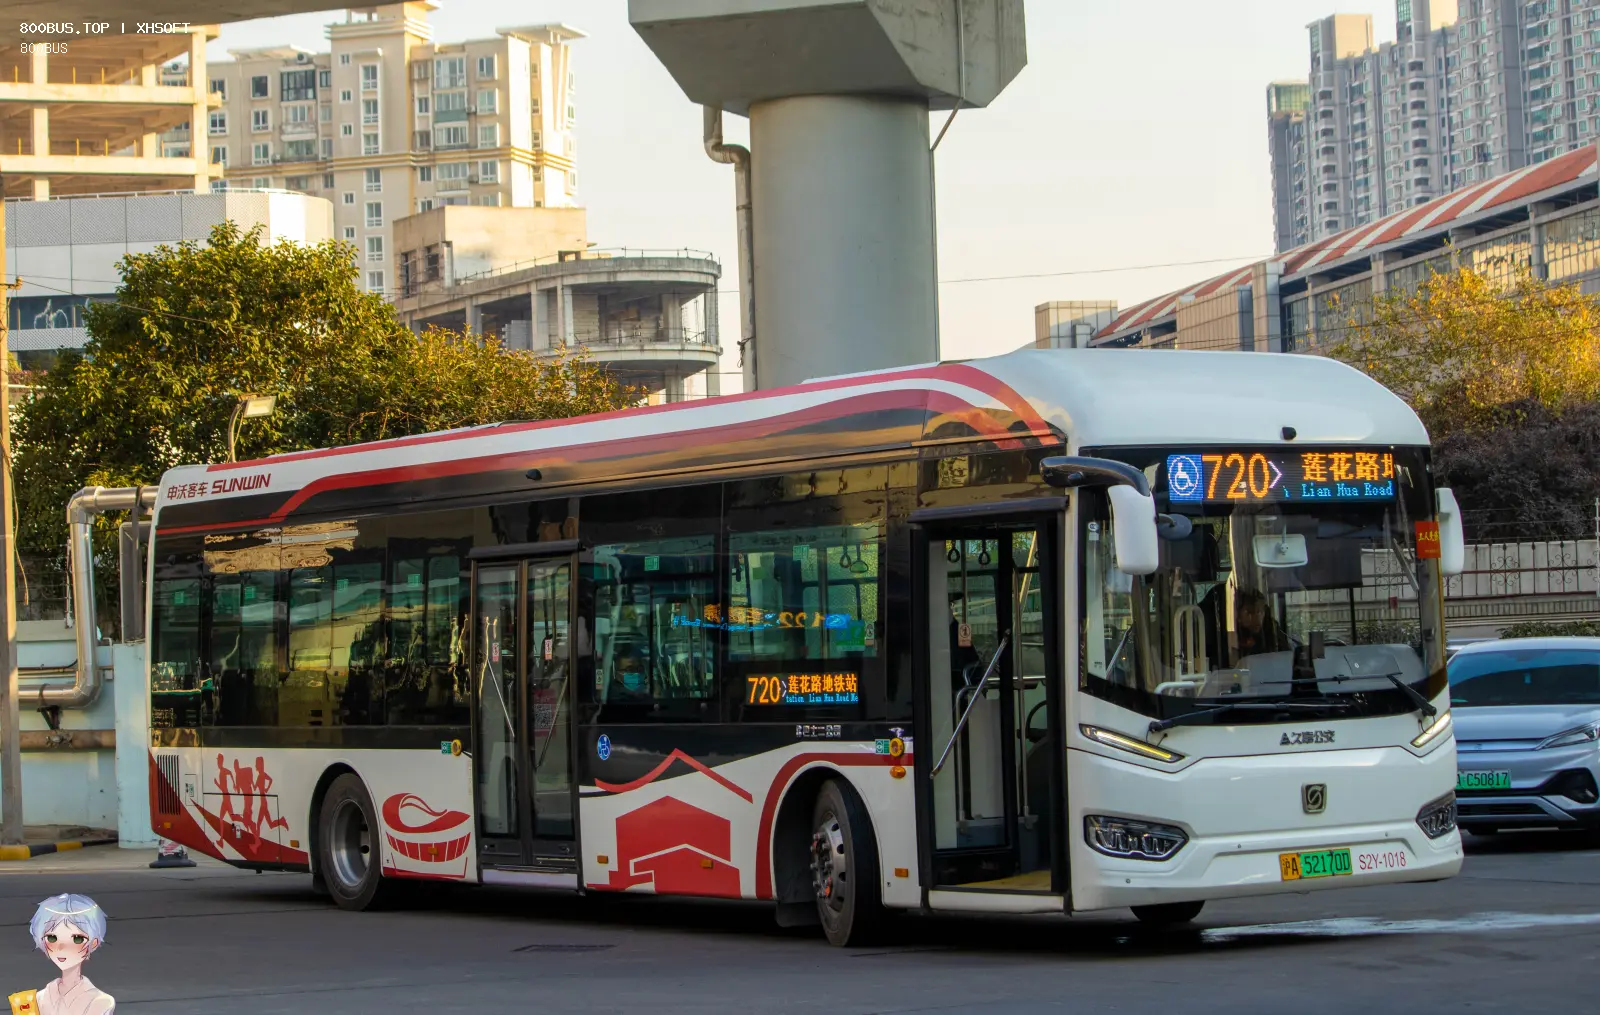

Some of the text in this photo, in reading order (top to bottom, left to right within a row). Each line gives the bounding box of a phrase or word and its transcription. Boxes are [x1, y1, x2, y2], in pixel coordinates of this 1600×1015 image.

[167, 473, 271, 500] 申沃客车 SUNWIN
[1202, 453, 1270, 499] 720
[1301, 482, 1332, 497] Lian
[1336, 482, 1359, 497] Hua
[1364, 480, 1393, 496] Road
[747, 676, 781, 704] 720
[788, 673, 858, 694] 莲花路地铁站
[1466, 772, 1508, 787] C50817
[1303, 852, 1351, 875] 52170D
[1359, 851, 1407, 870] S2Y-1018
